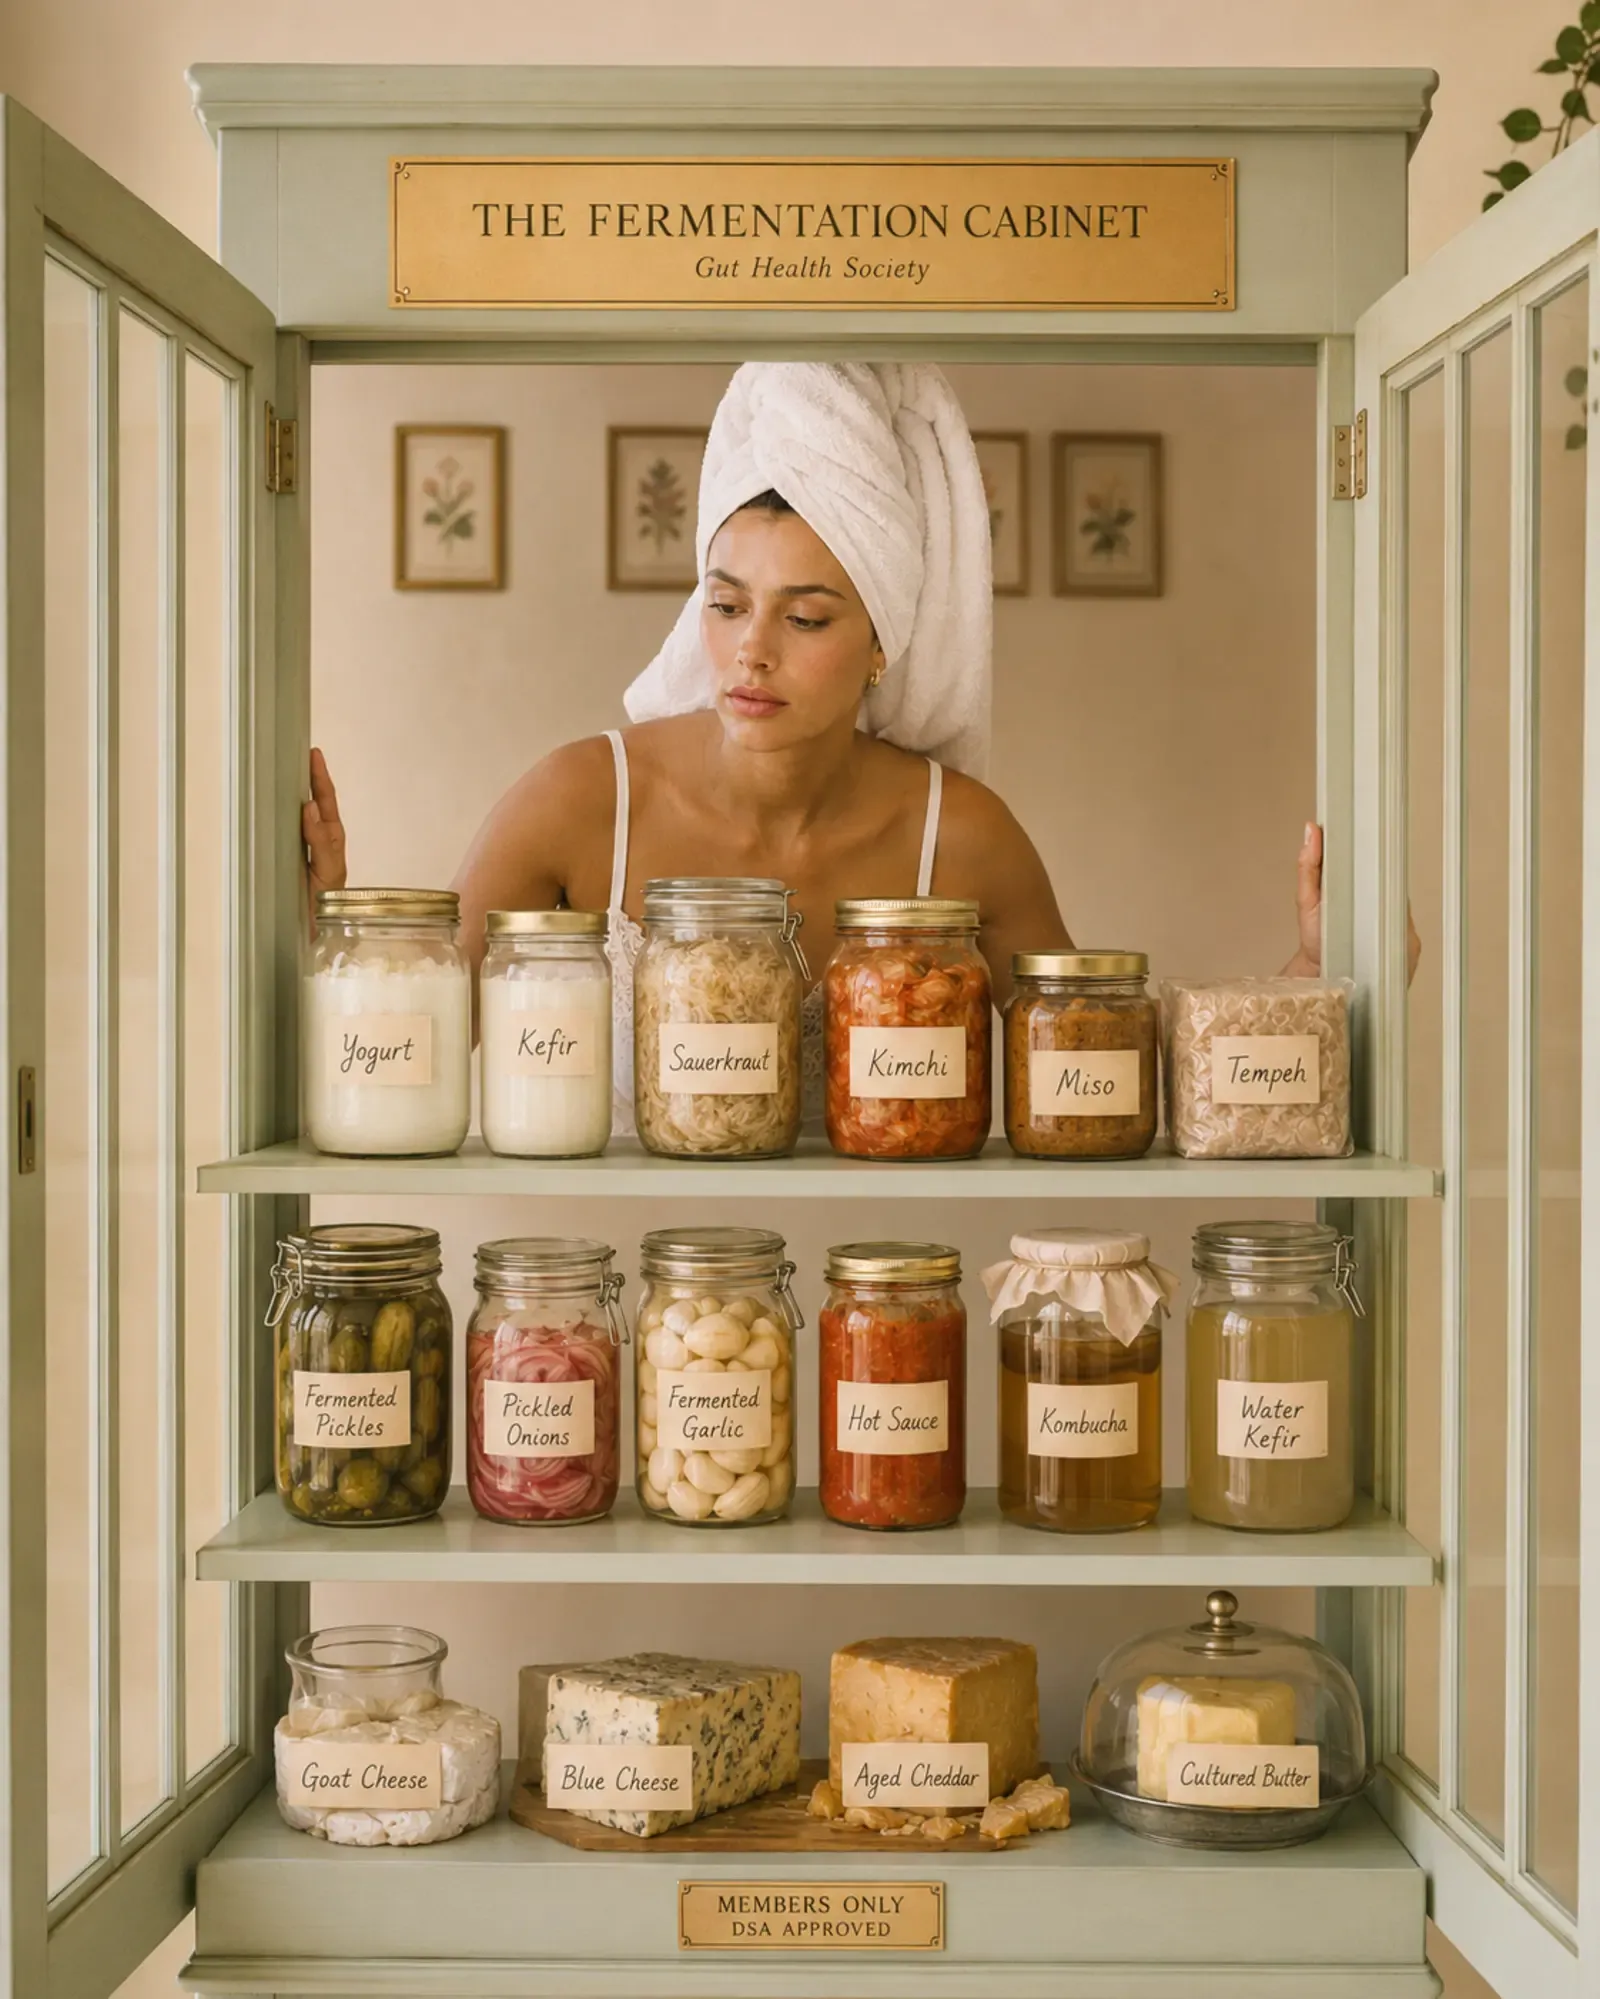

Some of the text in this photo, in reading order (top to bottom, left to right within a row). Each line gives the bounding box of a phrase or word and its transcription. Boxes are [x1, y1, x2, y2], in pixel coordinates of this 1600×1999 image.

[472, 203, 1149, 239] THE FERMENTATION CABINET
[695, 256, 931, 285] Gut Health Society
[340, 1033, 414, 1075] Yogurt
[518, 1028, 578, 1065] Kefir
[669, 1043, 771, 1072] Sauerkraut
[868, 1048, 949, 1077] Kimchi
[1228, 1054, 1307, 1093] Tempeh
[1056, 1068, 1115, 1096] Miso
[305, 1384, 398, 1411] Fermented
[503, 1391, 574, 1417] Pickled
[668, 1383, 761, 1410] Fermented
[1242, 1394, 1305, 1420] Water
[316, 1410, 384, 1438] Pickles
[682, 1411, 744, 1441] Garlic
[848, 1404, 939, 1432] Hot Sauce
[1039, 1406, 1130, 1434] Kombucha
[507, 1421, 570, 1446] Onions
[1244, 1424, 1301, 1454] Kefir
[301, 1762, 428, 1790] Goat Cheese
[561, 1764, 681, 1792] Blue Cheese
[854, 1762, 981, 1800] Aged Cheddar
[1180, 1760, 1314, 1788] Cultured Butter
[718, 1895, 905, 1914] MEMBERS ONLY
[732, 1921, 892, 1937] DSA APPROVED
